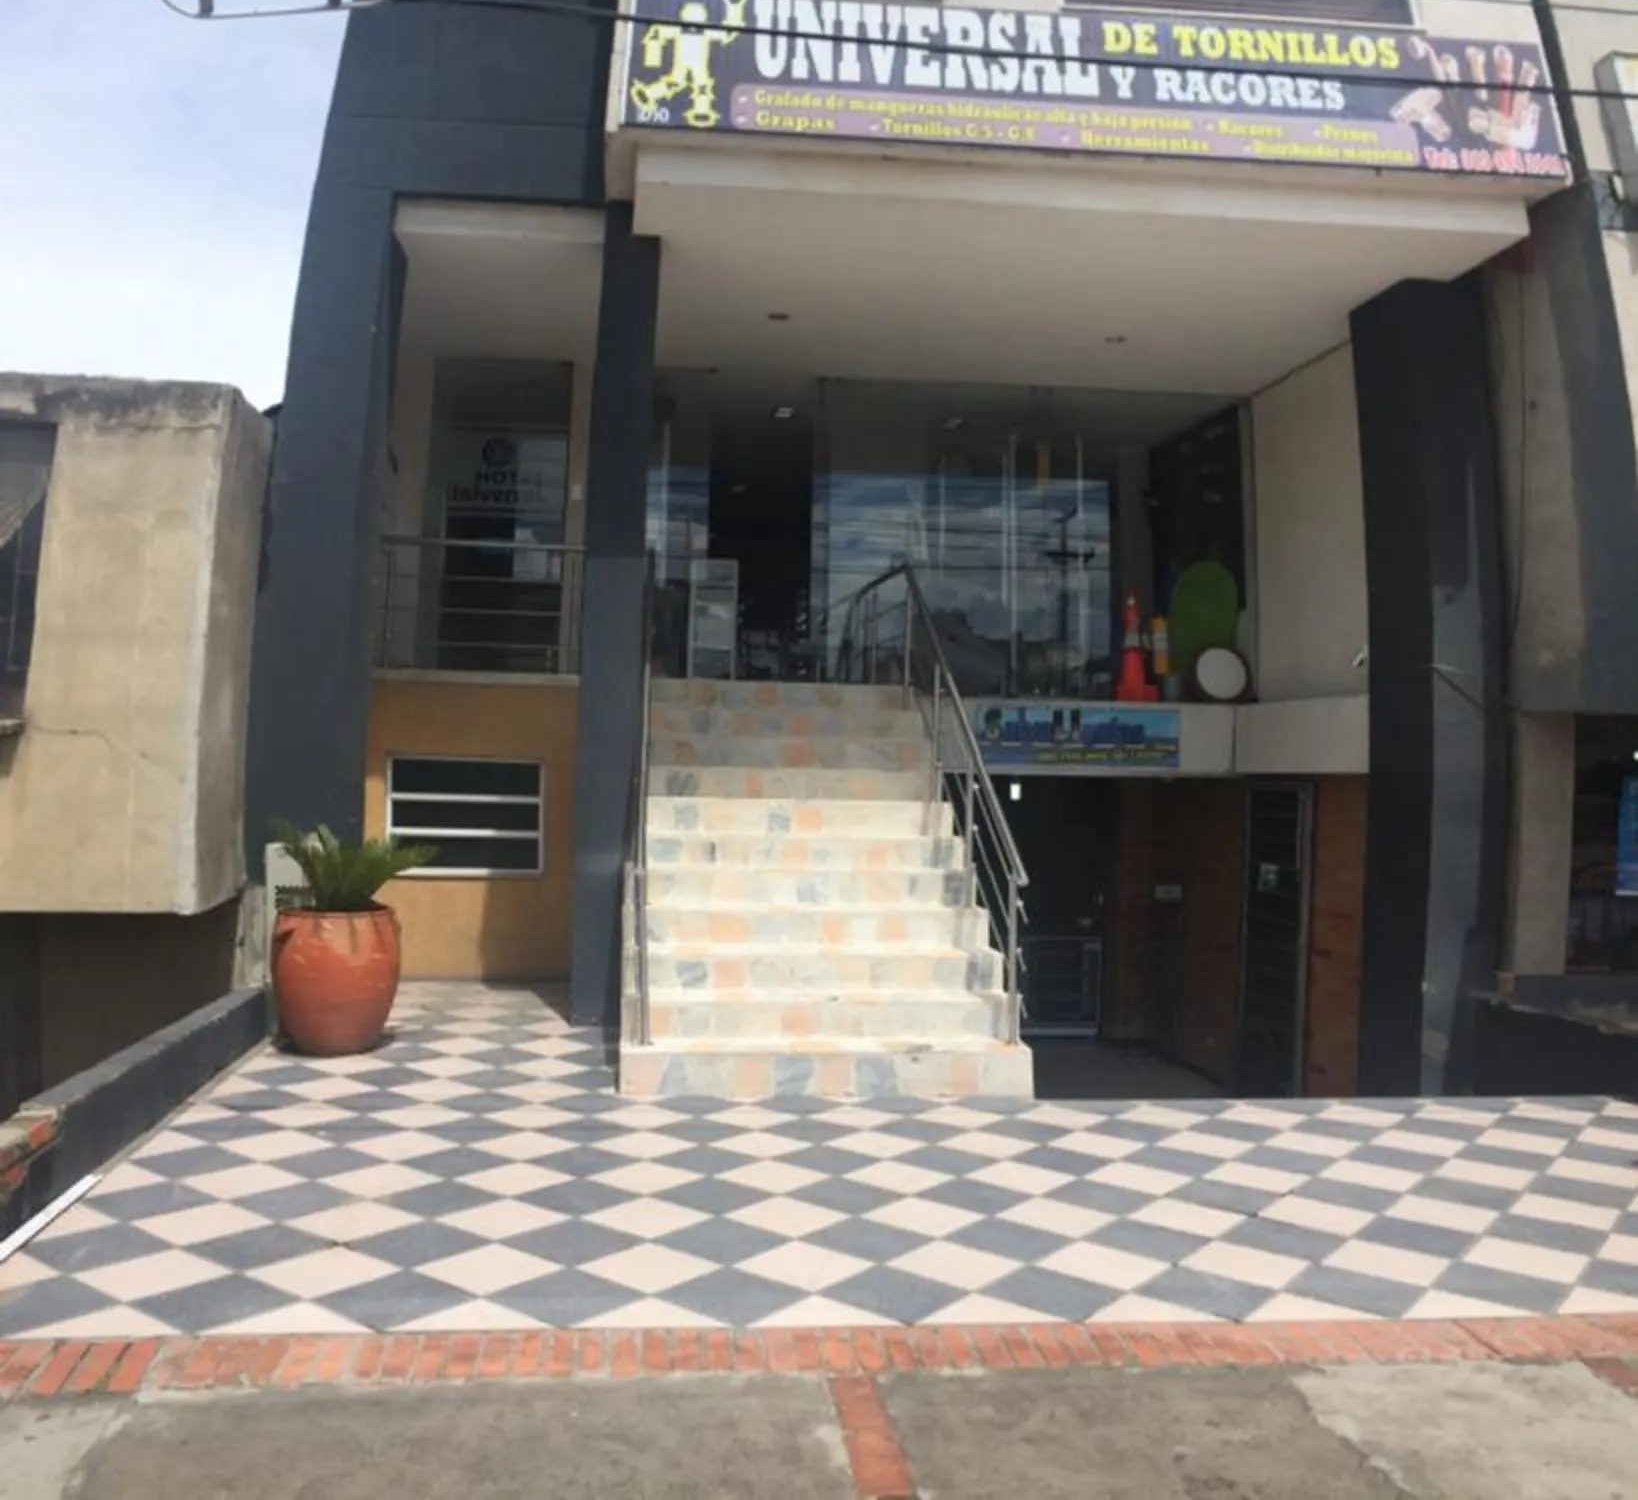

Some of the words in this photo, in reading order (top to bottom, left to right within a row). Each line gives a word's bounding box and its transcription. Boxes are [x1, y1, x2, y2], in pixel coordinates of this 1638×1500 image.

[1103, 22, 1159, 55] DE
[1174, 25, 1400, 69] TORNILLOS
[1109, 67, 1138, 98] Y
[1154, 70, 1346, 110] RACORES
[756, 110, 835, 131] Grapas
